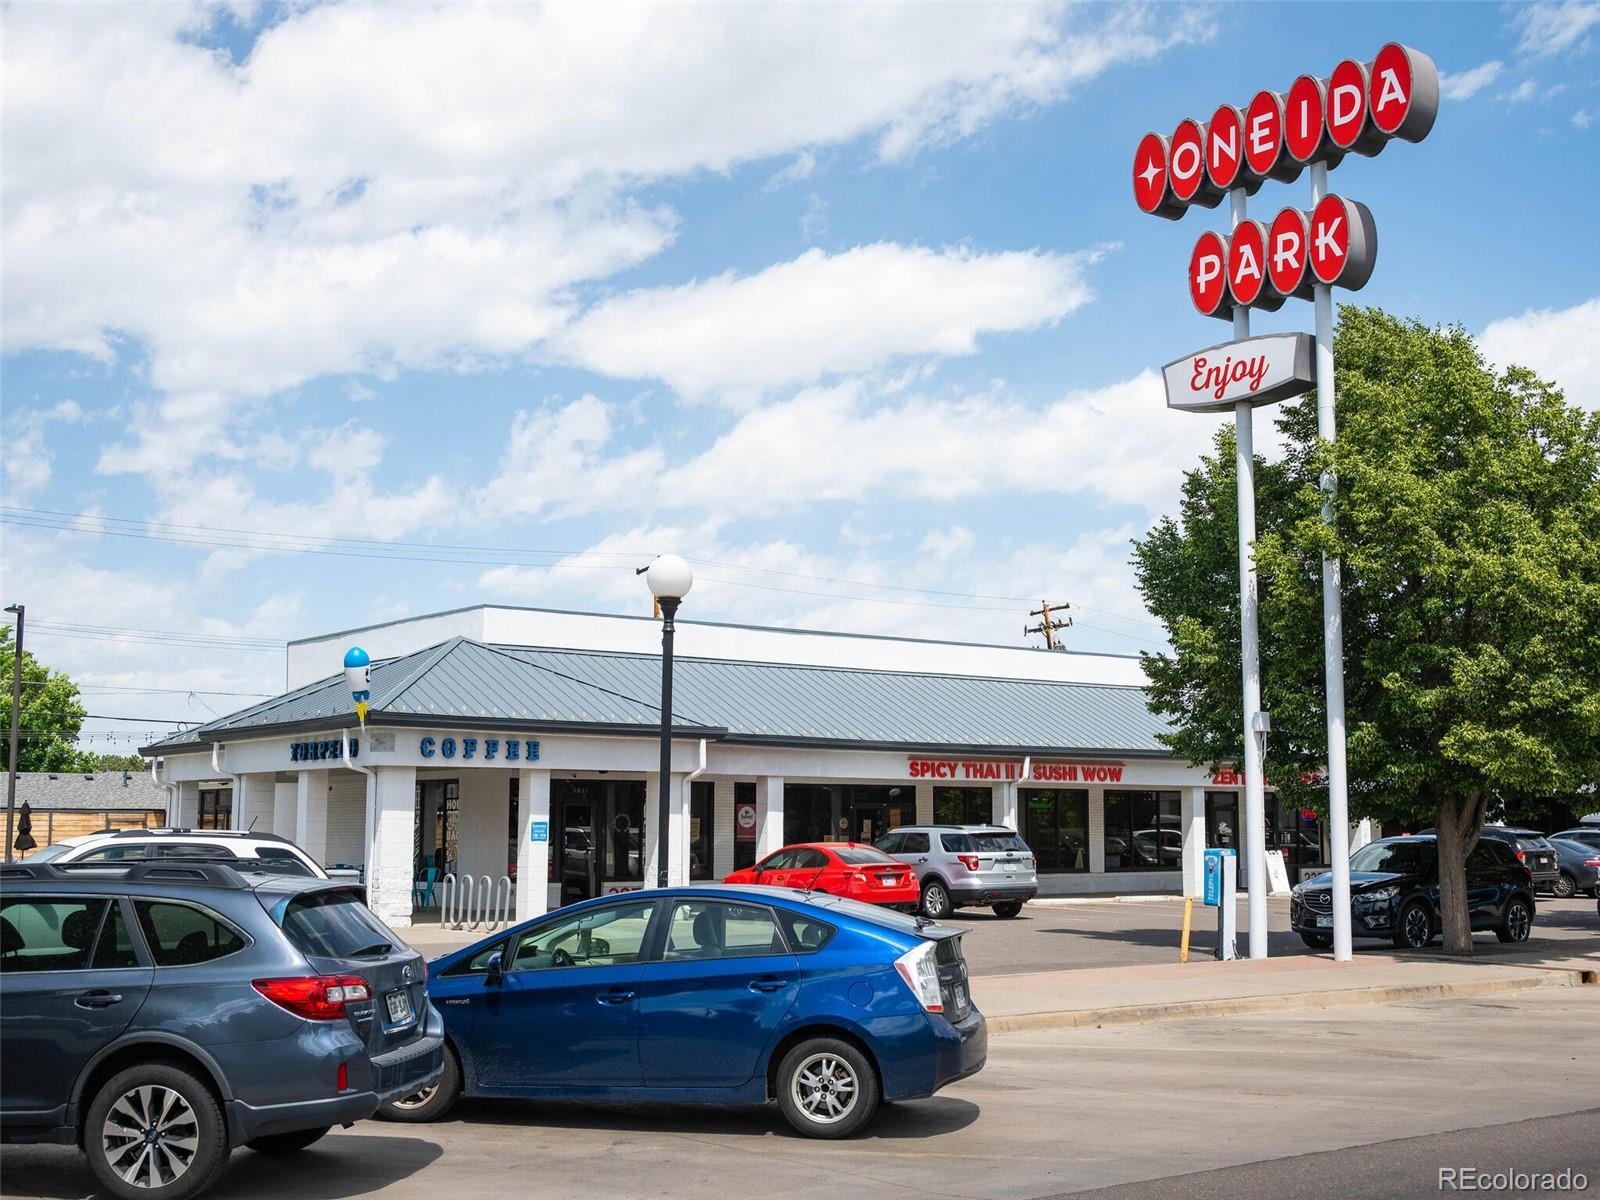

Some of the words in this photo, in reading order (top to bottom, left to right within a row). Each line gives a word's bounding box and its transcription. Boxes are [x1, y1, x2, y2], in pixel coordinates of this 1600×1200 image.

[1172, 68, 1406, 180] ONEIDA
[1197, 216, 1343, 294] PARK
[1190, 351, 1270, 399] Enjoy
[420, 736, 540, 760] COFFEE
[909, 760, 958, 778] SPICY
[962, 761, 1000, 779] THAI
[1005, 763, 1015, 779] II
[1033, 765, 1078, 781] SUSHI
[1081, 766, 1123, 782] WOW
[1212, 769, 1239, 785] ZEN
[1207, 860, 1215, 902] TELEPHOE
